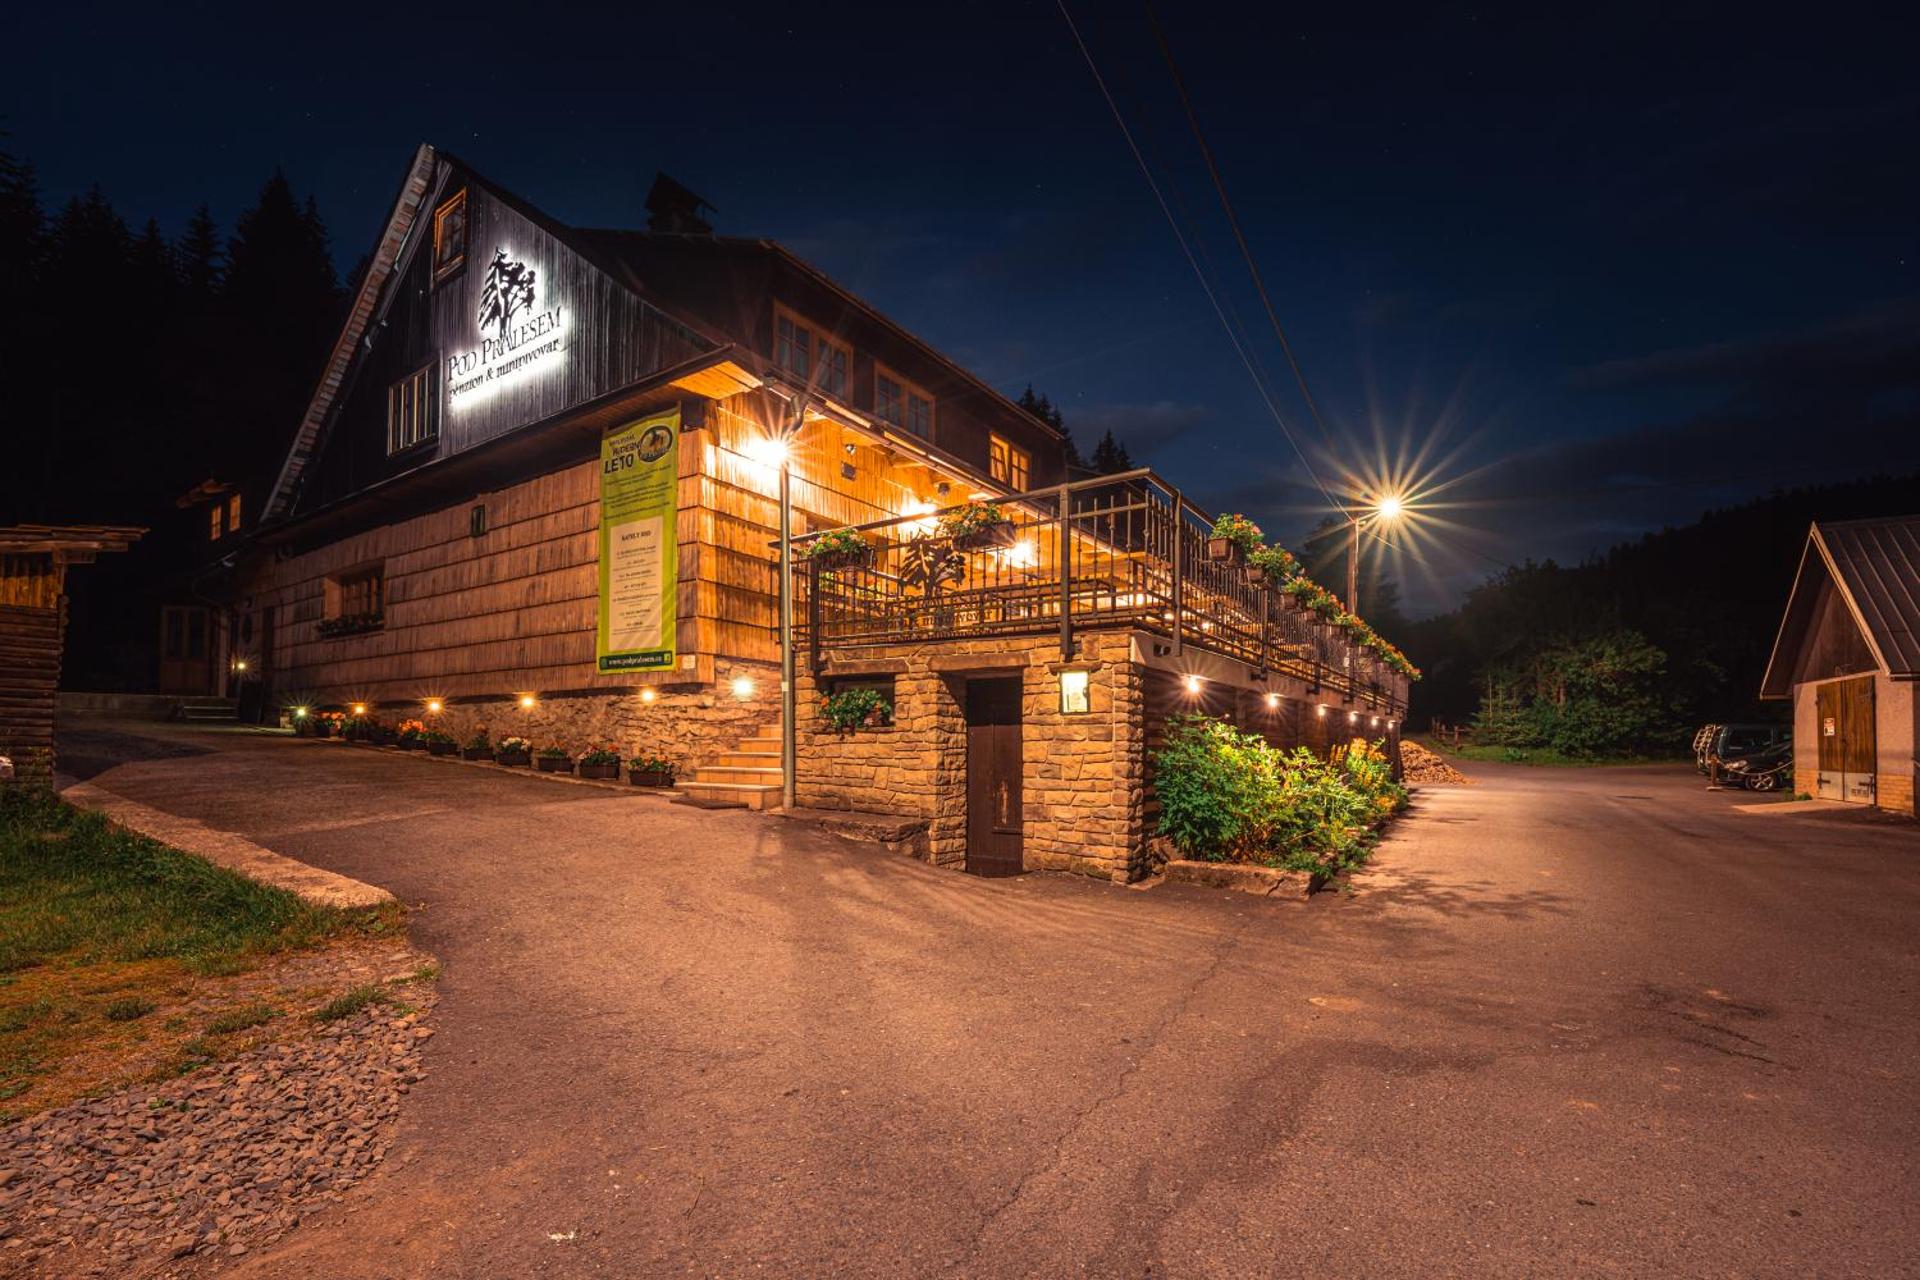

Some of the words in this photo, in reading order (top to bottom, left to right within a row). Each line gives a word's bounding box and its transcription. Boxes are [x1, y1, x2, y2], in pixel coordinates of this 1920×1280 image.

[447, 351, 477, 381] POD
[481, 306, 561, 365] PRALESEM
[486, 367, 494, 381] &
[496, 338, 561, 378] minipivovar
